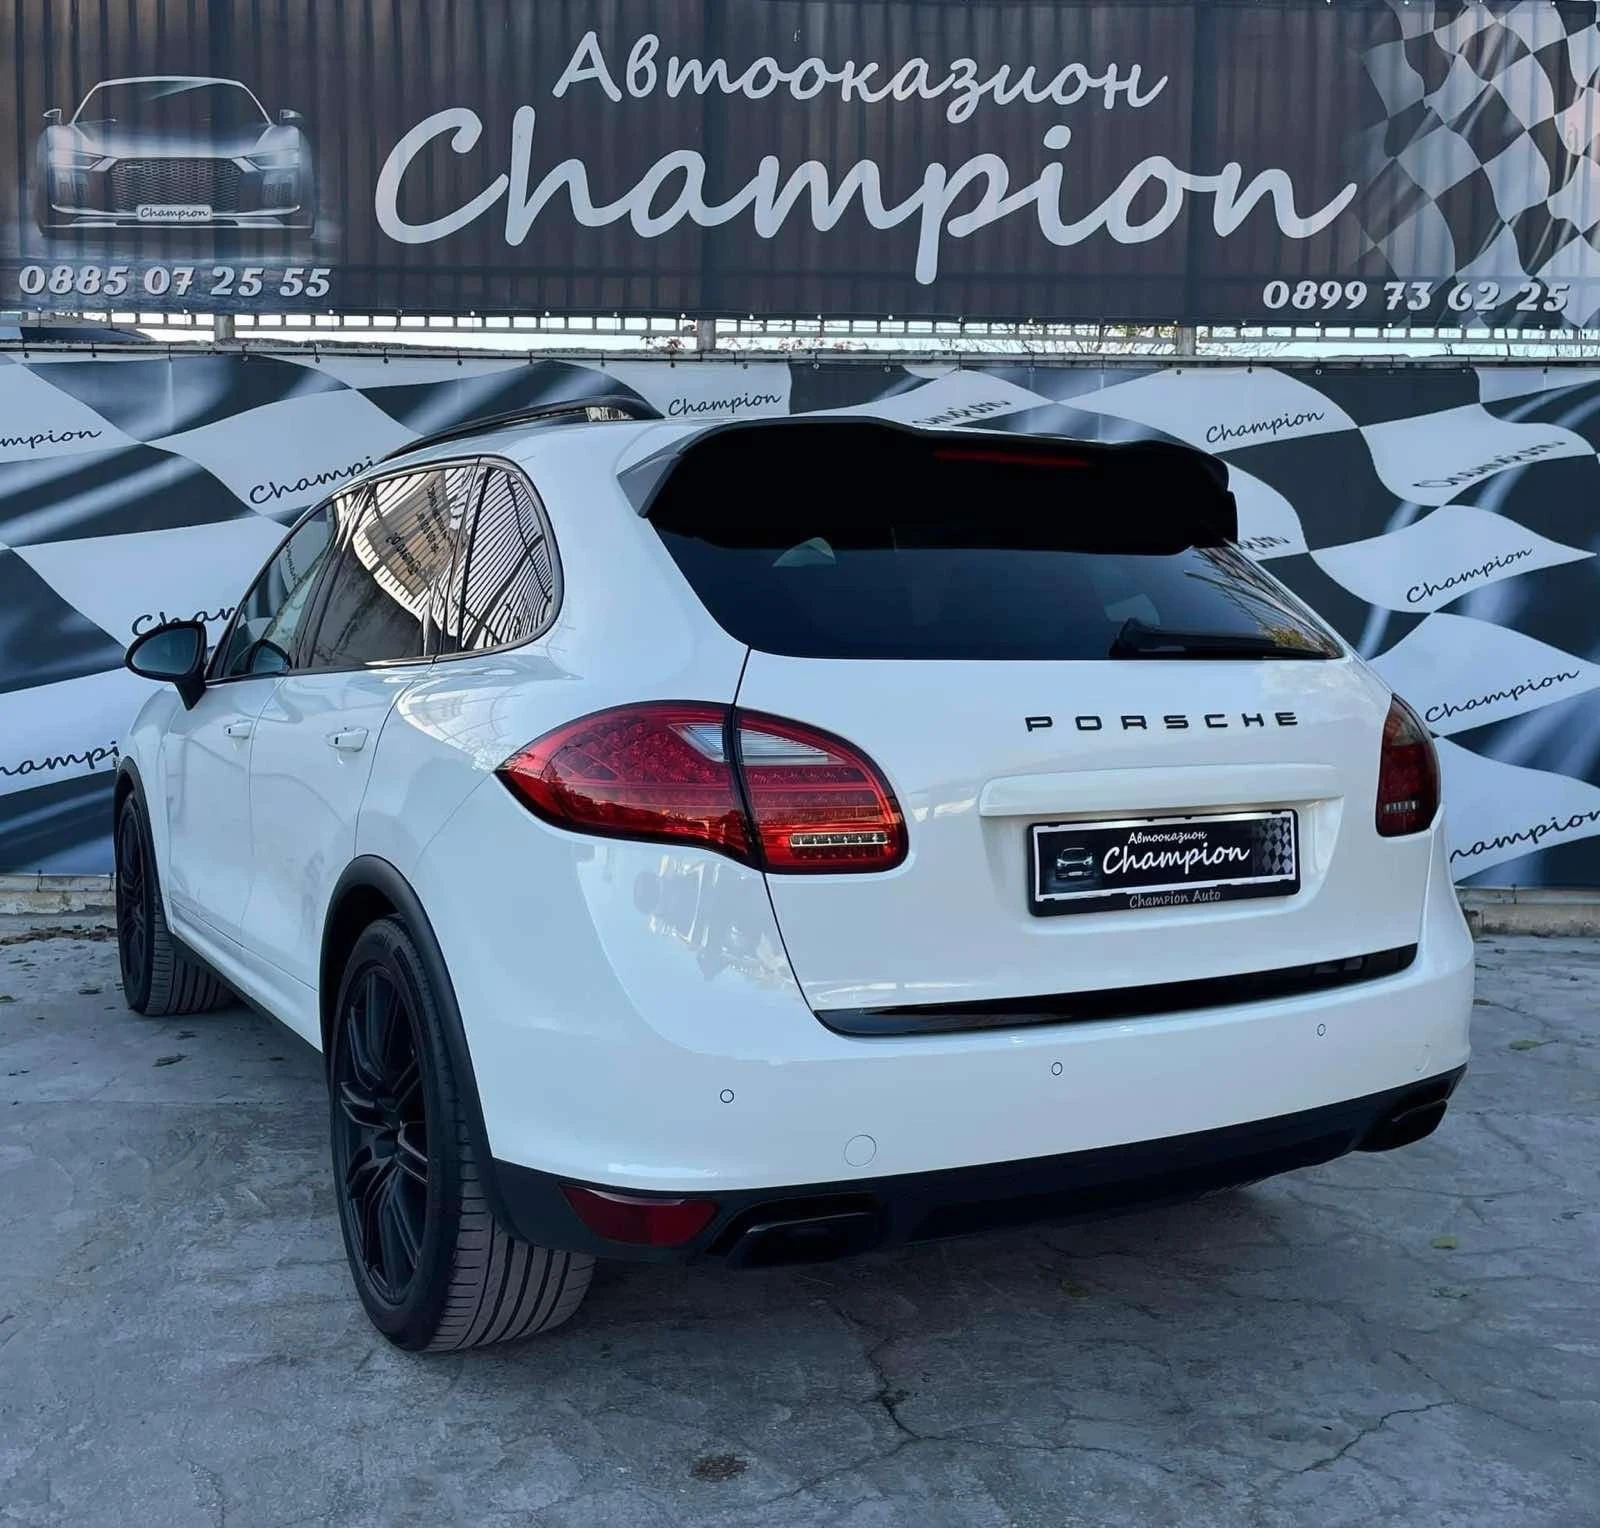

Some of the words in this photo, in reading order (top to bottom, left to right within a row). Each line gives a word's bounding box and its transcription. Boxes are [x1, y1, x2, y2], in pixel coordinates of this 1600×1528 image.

[553, 31, 1168, 124] Автооказион
[375, 106, 1357, 285] Champion
[140, 206, 209, 221] Champion
[19, 265, 128, 296] 0885
[144, 265, 194, 296] 07
[209, 266, 264, 297] 25
[279, 267, 331, 298] 55
[1263, 281, 1368, 311] 0899
[1384, 282, 1433, 311] 73
[1447, 282, 1500, 312] 62
[1516, 282, 1571, 312] 25
[669, 393, 782, 417] Champion
[1206, 410, 1325, 444] Champion
[1406, 548, 1535, 604] Champion
[1424, 669, 1580, 724] Champion
[1025, 711, 1298, 733] PORSCHE
[1127, 831, 1208, 845] Автооказион
[1102, 841, 1251, 875] Champion
[1129, 890, 1189, 909] Champion
[1192, 888, 1221, 903] Auto
